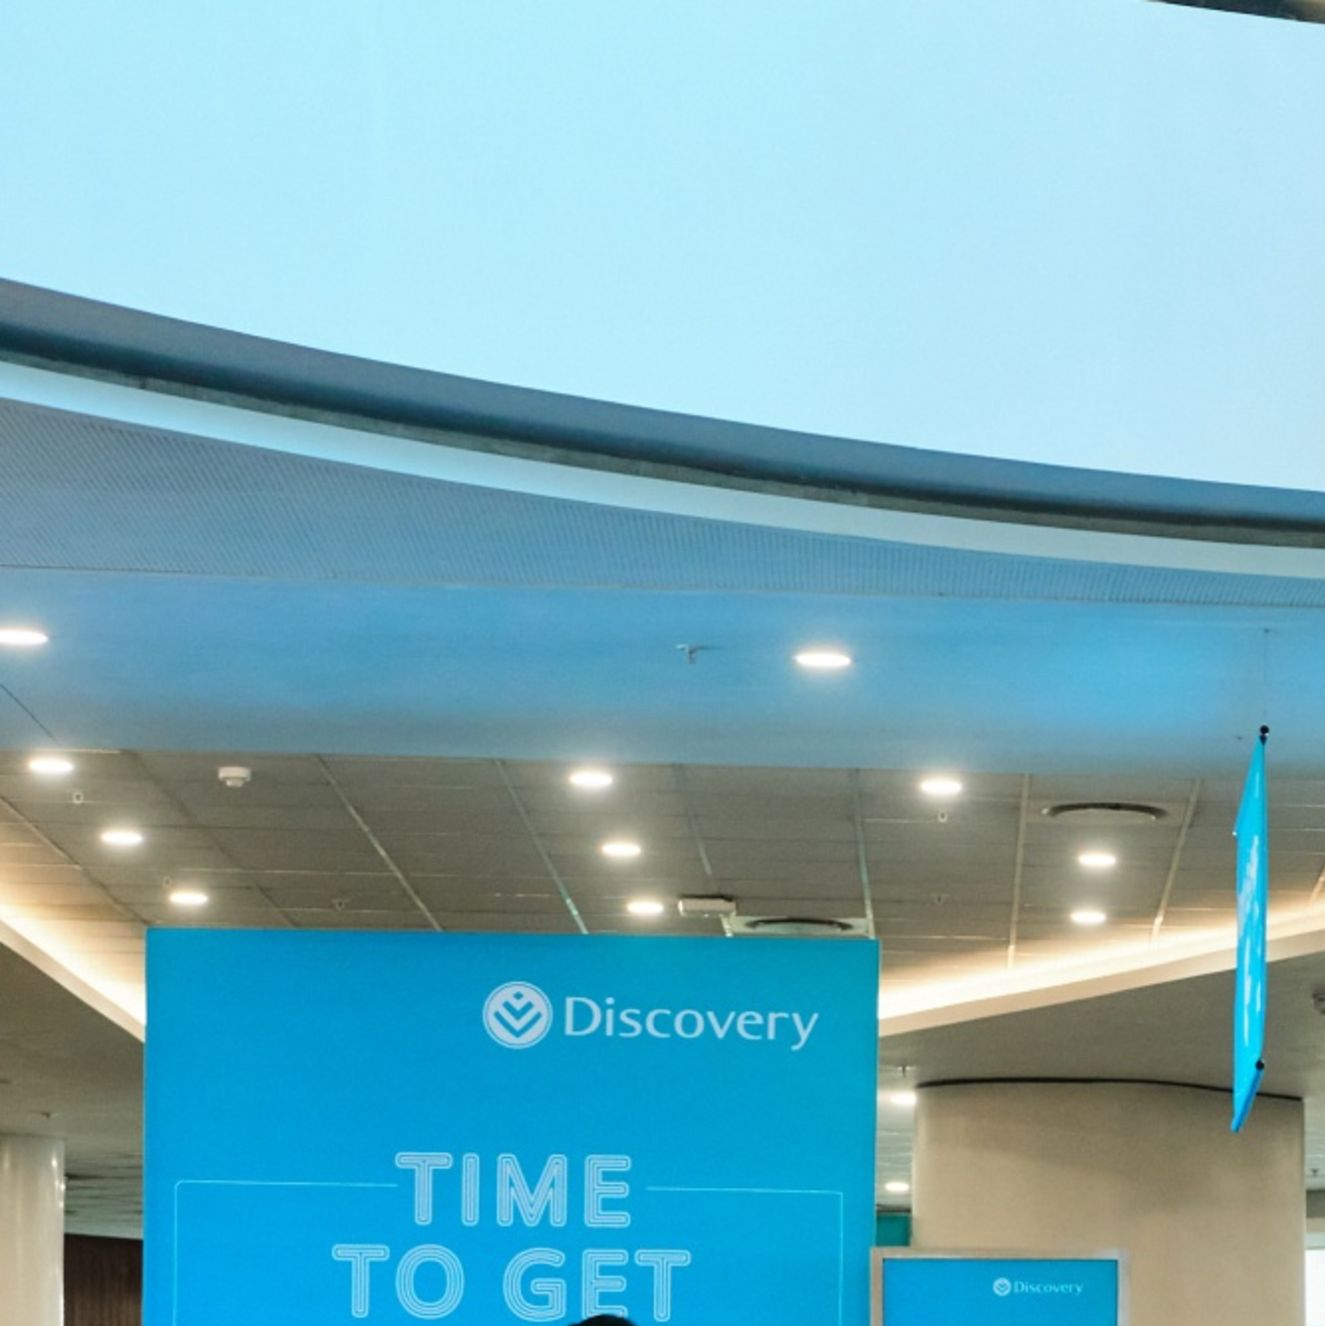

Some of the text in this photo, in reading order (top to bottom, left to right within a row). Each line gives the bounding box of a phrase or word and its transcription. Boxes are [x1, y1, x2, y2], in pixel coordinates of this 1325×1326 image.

[565, 996, 819, 1050] Discovery
[395, 1152, 632, 1228] TIME
[332, 1244, 691, 1323] TO GET
[1013, 1280, 1084, 1295] Discovery
